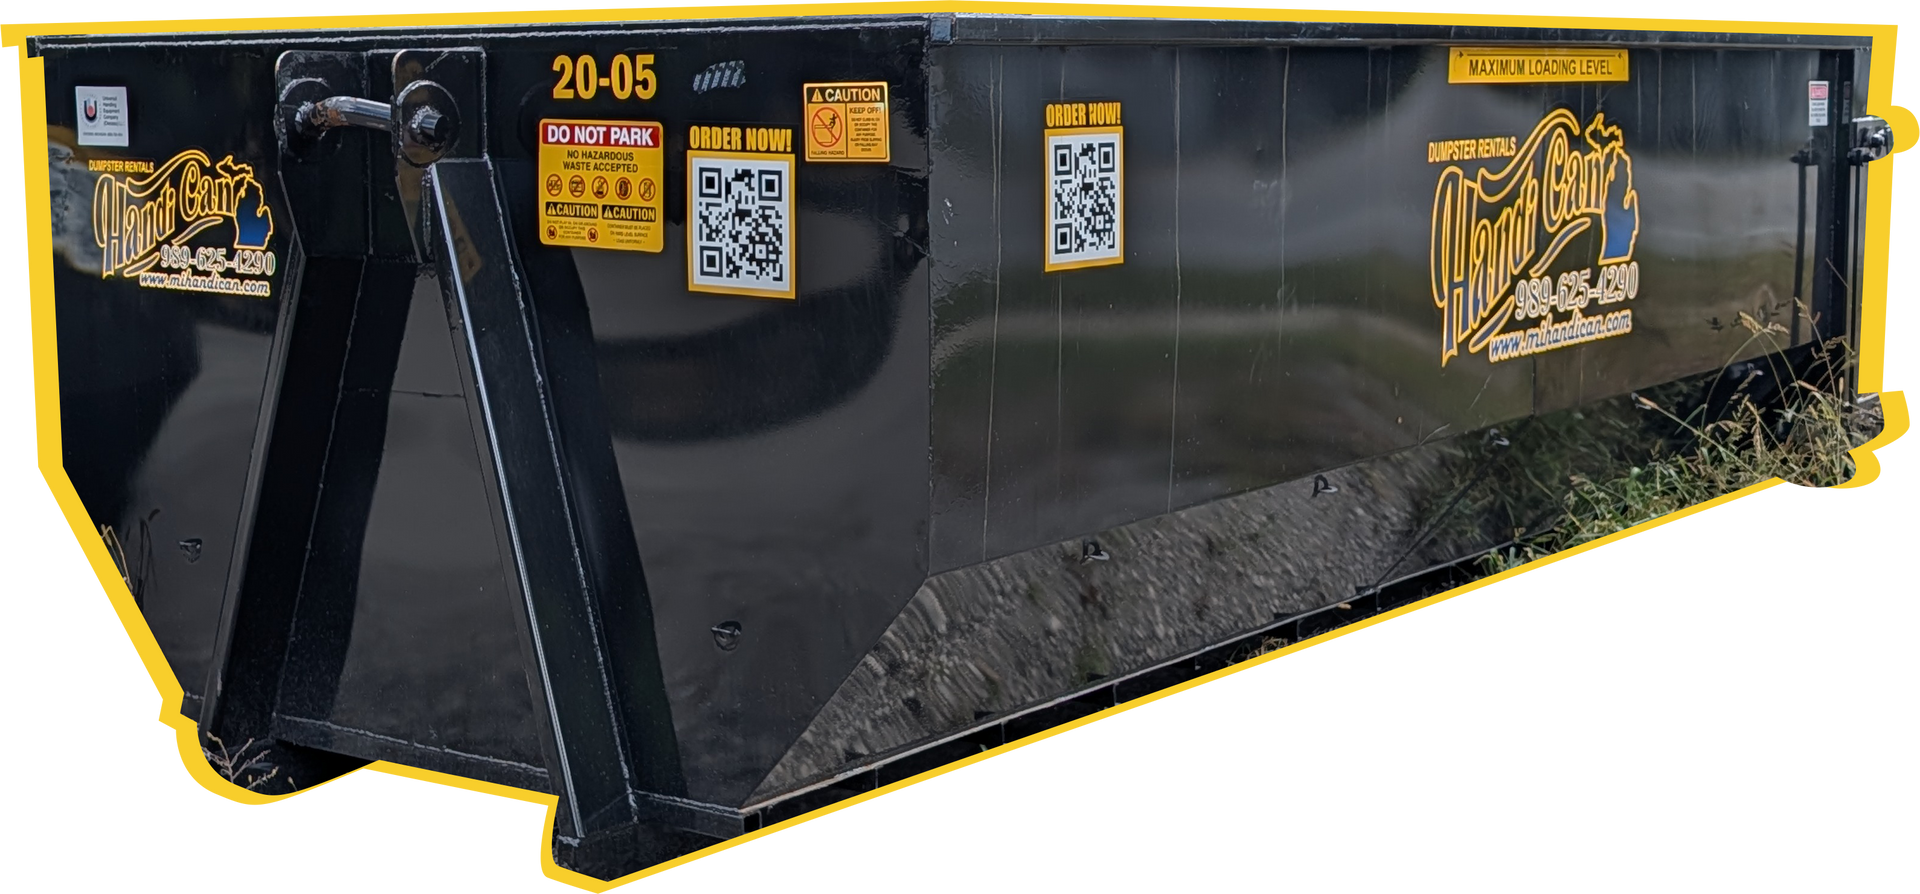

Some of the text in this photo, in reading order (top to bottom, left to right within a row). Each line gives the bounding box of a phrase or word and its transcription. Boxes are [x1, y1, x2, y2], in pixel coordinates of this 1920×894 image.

[552, 54, 658, 100] 20-05
[1469, 59, 1612, 76] MAXIMUM LOADING LEVEL
[825, 88, 880, 102] CAUTION
[1046, 102, 1122, 127] ORDER NOW!
[547, 124, 654, 146] DO NOT PARK
[689, 126, 792, 152] ORDER NOW!
[567, 149, 634, 162] NO HAZARDOUS
[1428, 136, 1517, 163] DUMPSTER RENTALS
[88, 158, 154, 174] DUMPSTER RENTALS
[563, 161, 638, 173] WASTE ACCEPTED
[94, 160, 236, 279] Handi Can
[556, 204, 598, 217] CAUTION
[613, 207, 655, 221] CAUTION
[1431, 126, 1604, 368] Handi Can
[160, 244, 276, 276] 989-625-4290
[139, 268, 270, 296] www.mihandican.com
[1514, 262, 1640, 320] 989-625-4290
[1488, 308, 1632, 362] www.mihandican.com
